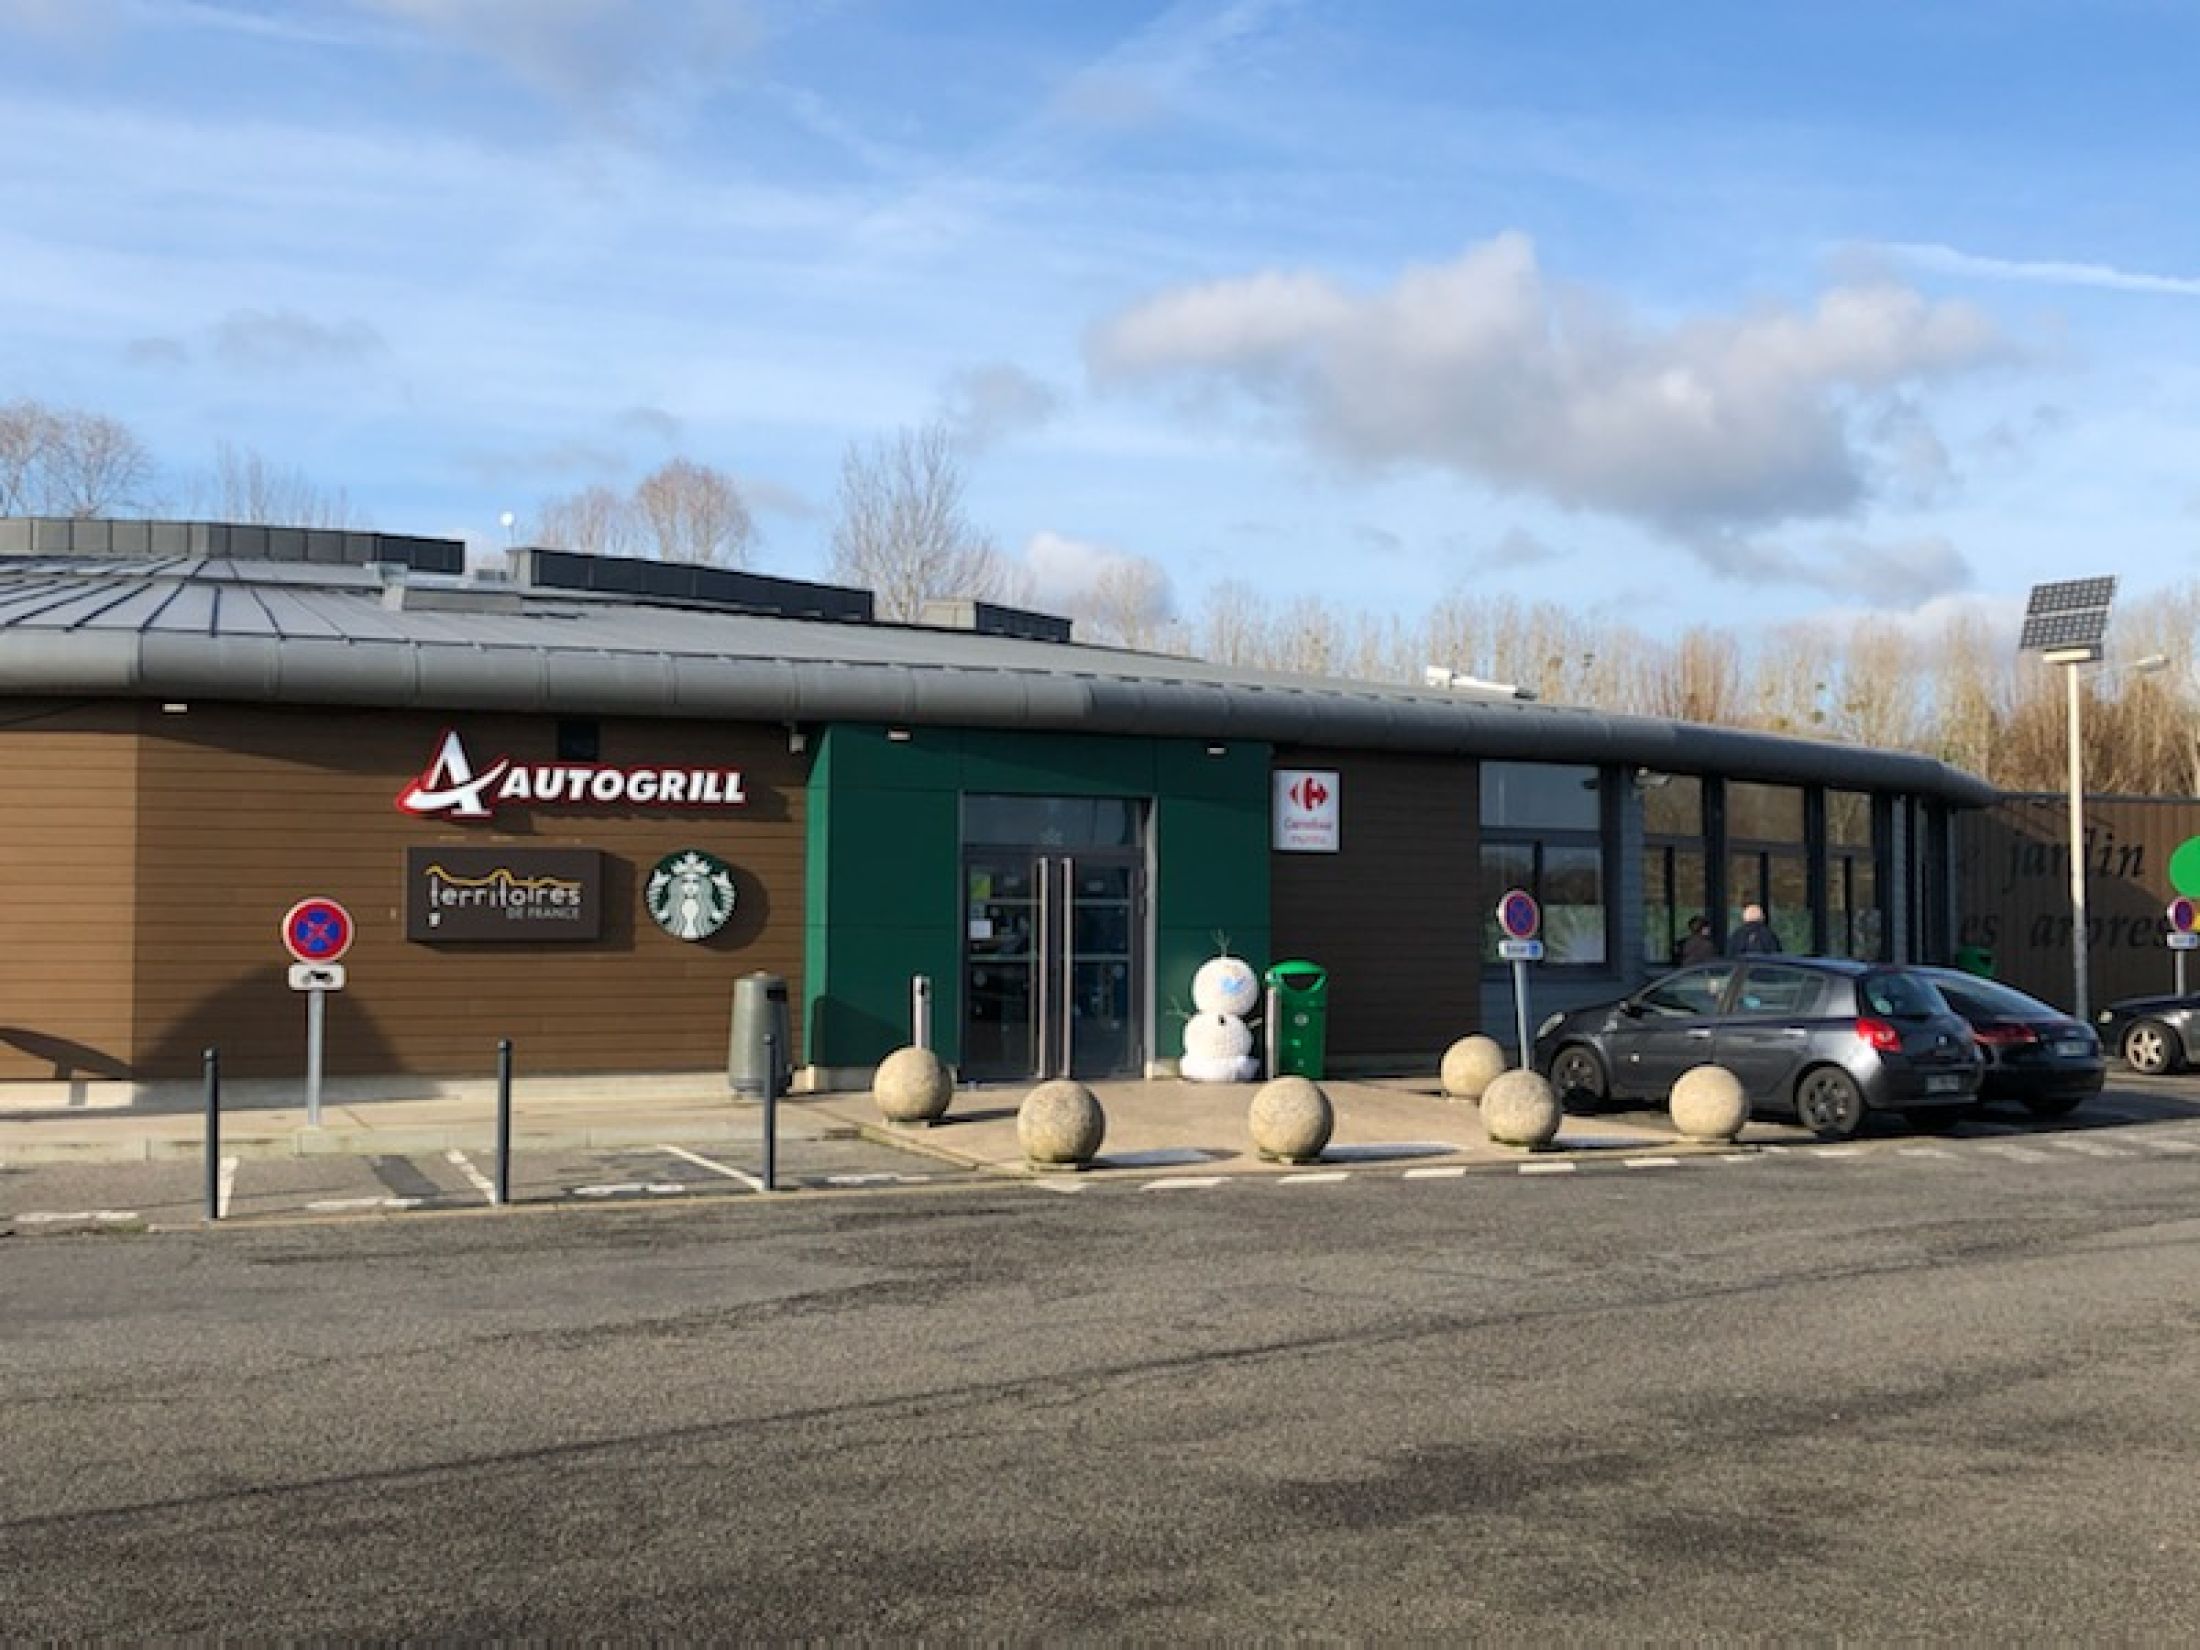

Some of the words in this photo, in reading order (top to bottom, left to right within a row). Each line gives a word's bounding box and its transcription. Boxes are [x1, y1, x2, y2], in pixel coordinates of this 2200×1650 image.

[497, 766, 746, 804] AUTOGRILL
[427, 866, 582, 908] territoires
[528, 906, 580, 920] FRANCE
